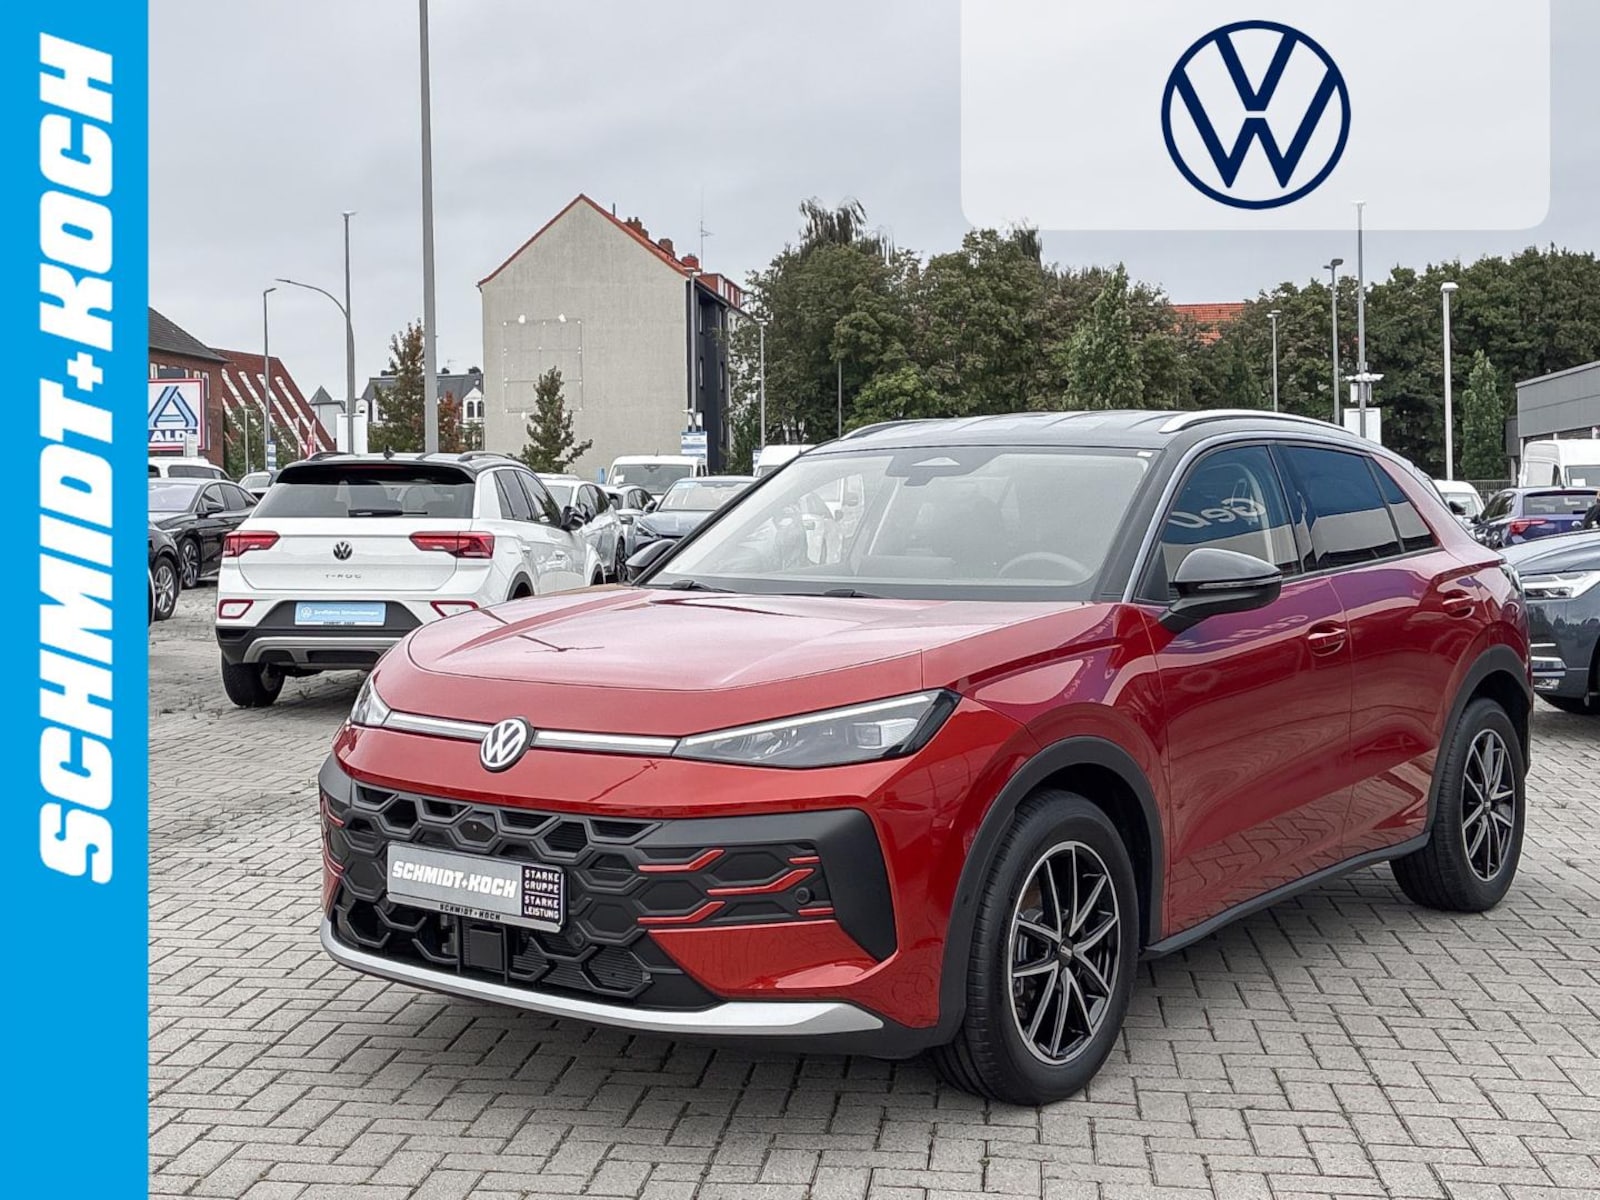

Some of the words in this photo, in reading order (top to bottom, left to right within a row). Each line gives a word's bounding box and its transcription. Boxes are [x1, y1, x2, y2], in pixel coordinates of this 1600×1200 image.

[391, 860, 518, 899] SCHMIDT+KOCH
[524, 869, 559, 882] STARKE
[524, 880, 559, 893] GRUPPE
[524, 894, 559, 908] STARKE
[523, 904, 559, 919] LEISTUNG
